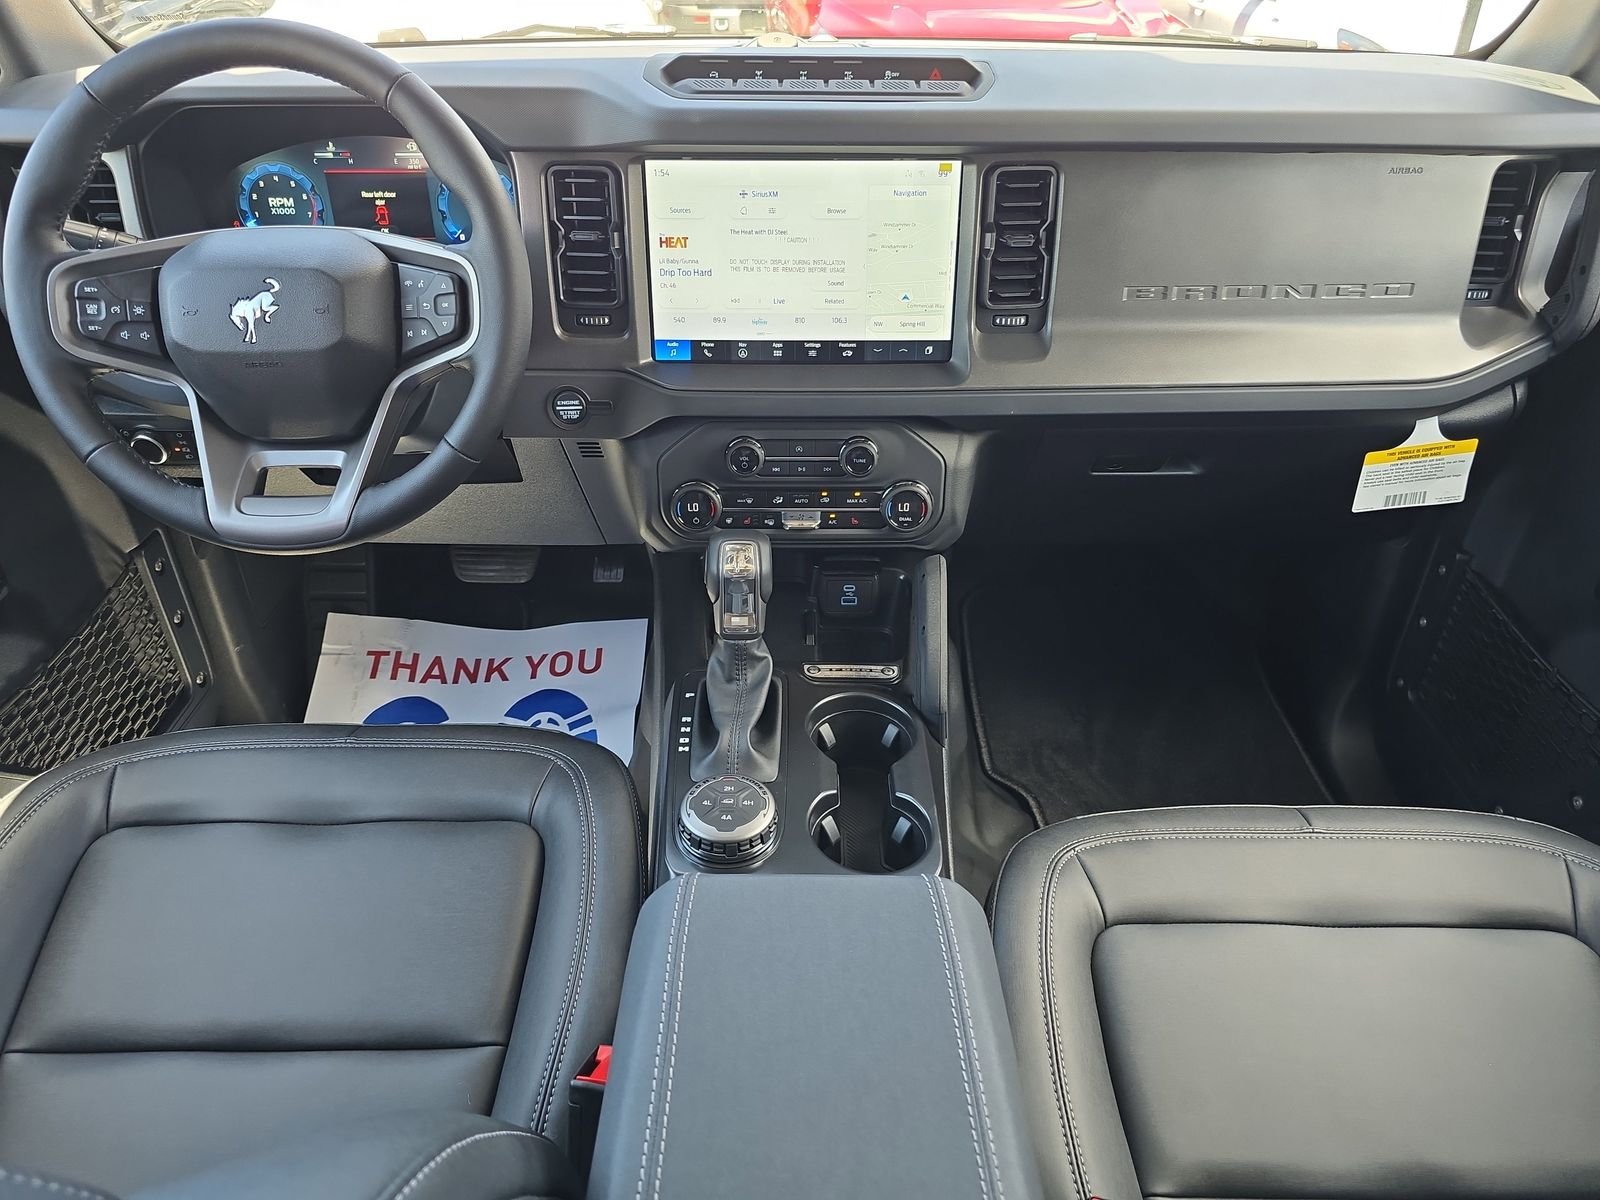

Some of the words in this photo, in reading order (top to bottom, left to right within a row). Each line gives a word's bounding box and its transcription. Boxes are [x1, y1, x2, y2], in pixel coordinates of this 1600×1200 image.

[1387, 167, 1423, 175] AIRBAG
[893, 190, 927, 198] Navigation
[268, 197, 294, 207] RPM
[660, 237, 688, 248] HEAT
[660, 268, 676, 277] Drip
[1122, 282, 1416, 301] BRONCO
[688, 503, 699, 511] LO
[899, 503, 909, 512] LO
[366, 650, 513, 685] THANK
[524, 648, 604, 680] YOU
